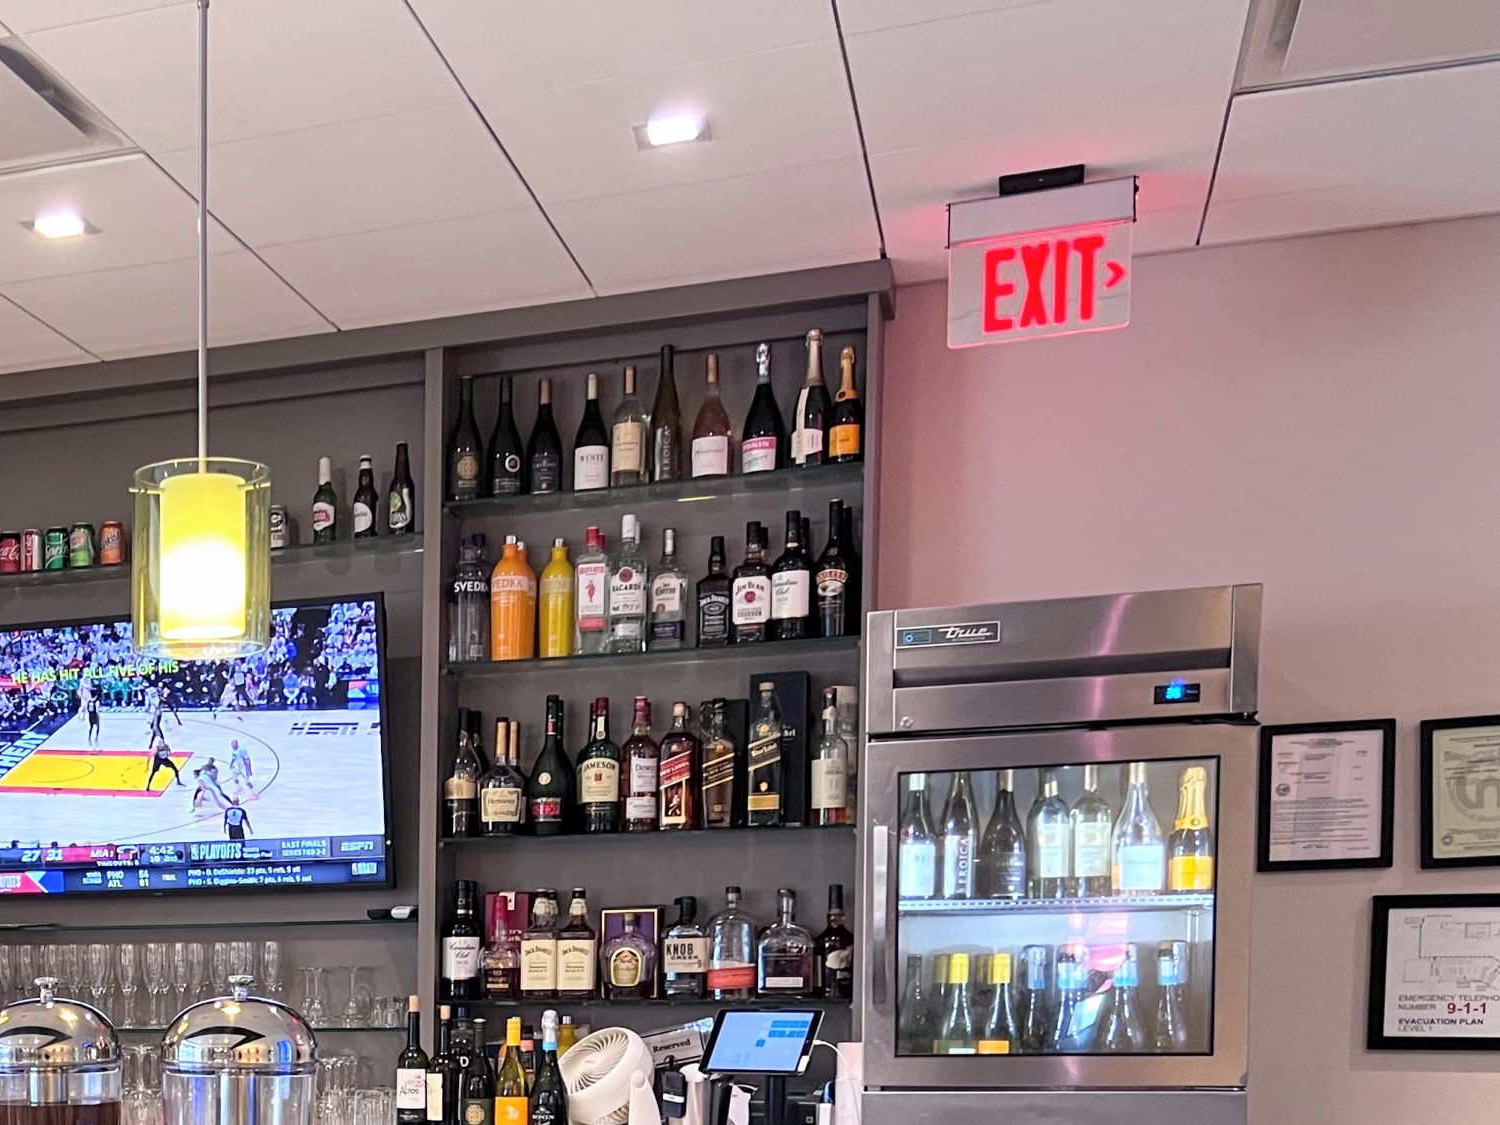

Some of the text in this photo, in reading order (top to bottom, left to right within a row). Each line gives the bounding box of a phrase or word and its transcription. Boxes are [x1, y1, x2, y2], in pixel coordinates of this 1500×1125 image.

[982, 235, 1105, 334] EXIT
[454, 581, 489, 592] SVEDKA
[12, 661, 180, 685] HE HAS HIT ALL FIVE OF HIS
[583, 761, 616, 773] JAMESON
[149, 845, 174, 855] 4:42
[281, 841, 300, 849] EAST
[340, 841, 375, 852] ESPN
[21, 849, 42, 863] 27
[45, 849, 64, 861] 31
[200, 843, 242, 860] PLAYOFFS
[106, 871, 124, 880] PHO
[108, 880, 123, 888] ATL
[666, 943, 694, 956] KNOB
[1398, 994, 1456, 1002] EMERGENCY
[1447, 1002, 1486, 1014] 9-1-1
[652, 1038, 691, 1053] Reserved
